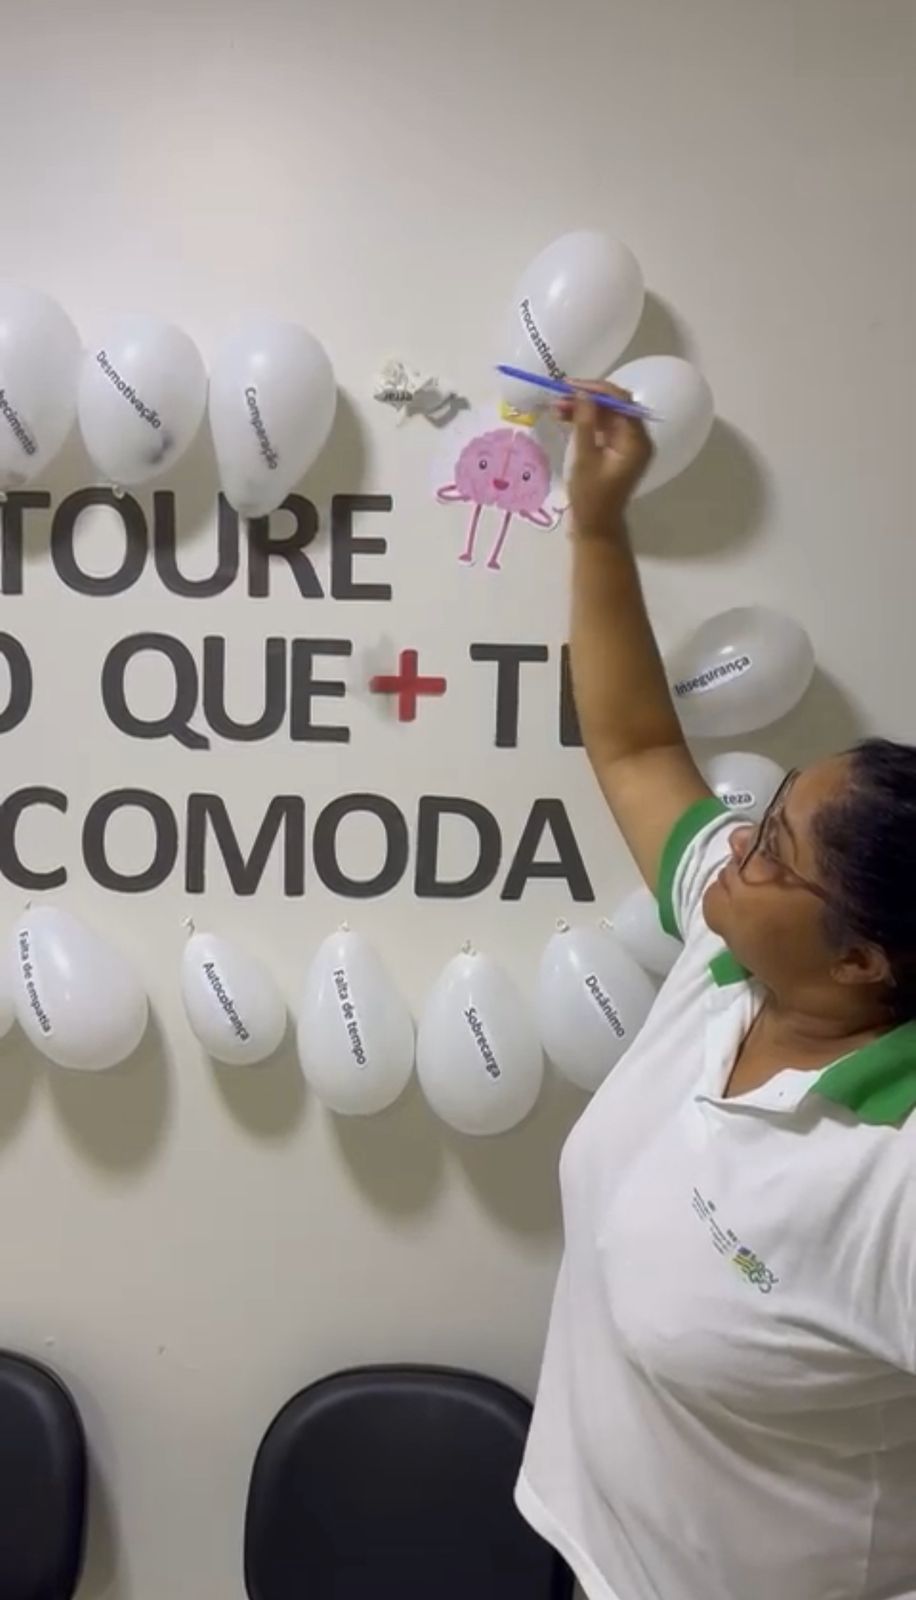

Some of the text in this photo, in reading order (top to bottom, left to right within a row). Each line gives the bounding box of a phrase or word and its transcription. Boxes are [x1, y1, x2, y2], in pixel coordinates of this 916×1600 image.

[520, 299, 566, 380] Procrastinaçã
[96, 350, 161, 429] Desmotivação
[245, 387, 278, 470] Comparação
[101, 633, 355, 750] QUE
[674, 655, 750, 697] Insegurança
[0, 786, 595, 902] COMODA
[19, 931, 51, 1033] Falta de empatia
[203, 962, 250, 1042] Autocobrança
[333, 969, 366, 1065] Falta de tempo
[585, 976, 625, 1038] Desânimo
[465, 1008, 501, 1079] Sobrecarga
